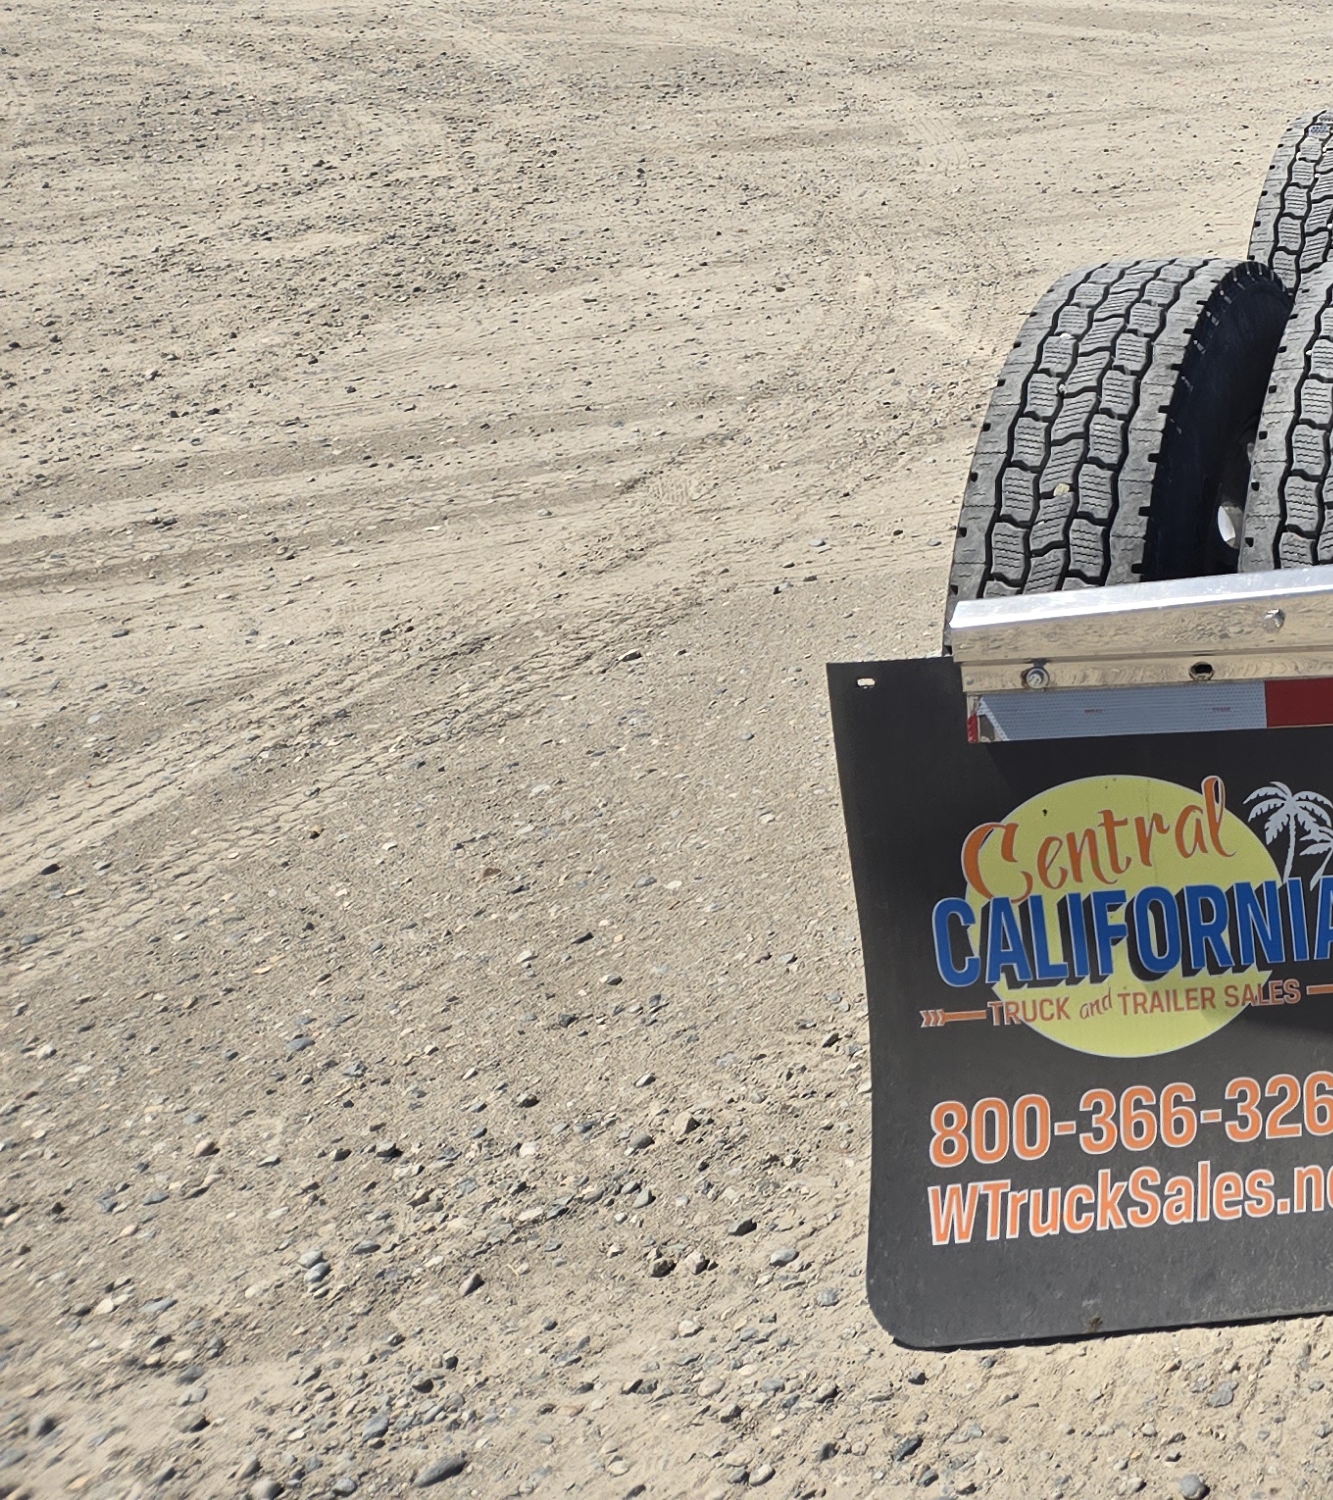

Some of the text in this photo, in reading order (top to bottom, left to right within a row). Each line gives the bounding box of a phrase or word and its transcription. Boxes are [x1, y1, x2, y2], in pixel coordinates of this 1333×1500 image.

[962, 775, 1238, 902] Central
[988, 979, 1302, 1027] TRUCK and TRAILER SALES
